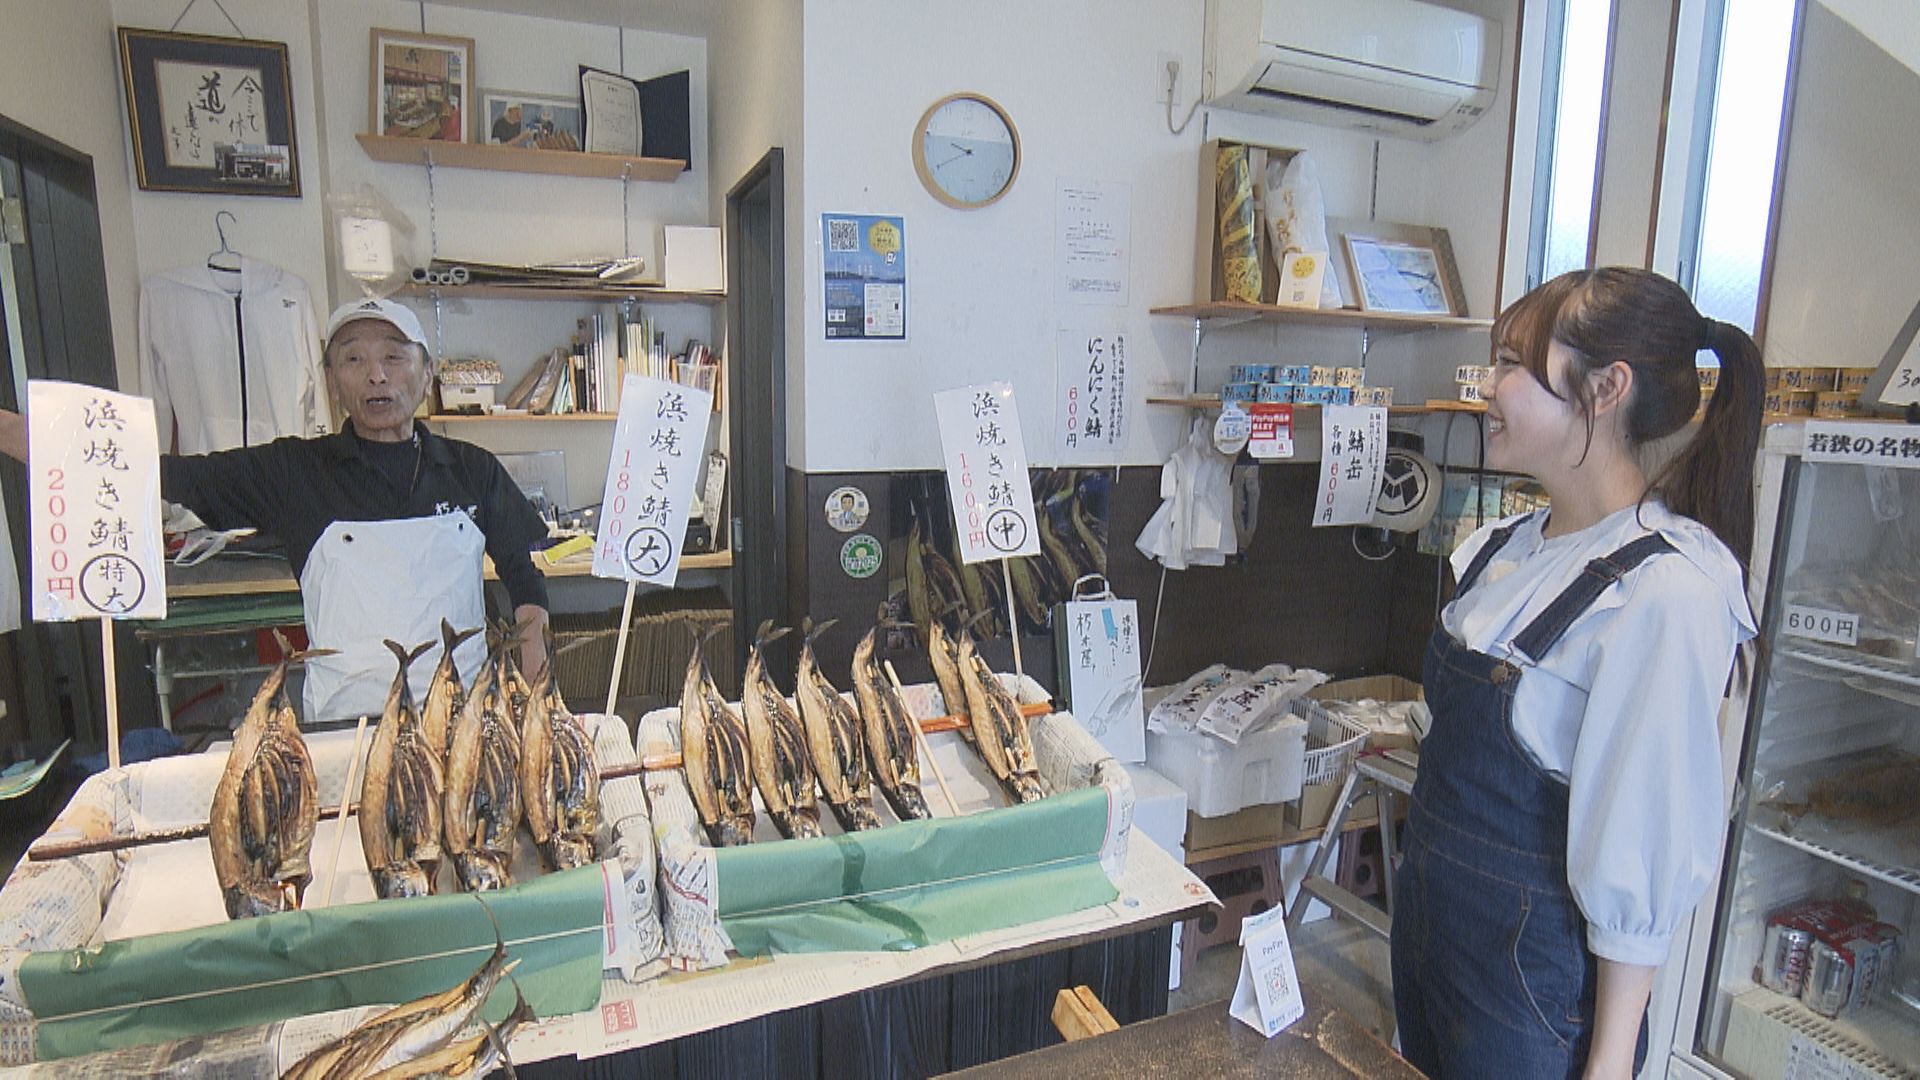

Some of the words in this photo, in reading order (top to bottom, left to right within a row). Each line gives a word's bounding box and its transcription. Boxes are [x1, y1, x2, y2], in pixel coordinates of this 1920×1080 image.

[1067, 387, 1078, 448] 600円
[1085, 337, 1105, 438] にんにく鯖
[84, 399, 134, 550] 浜焼き鯖
[638, 391, 689, 527] 浜焼き鯖
[972, 391, 1016, 508] 浜焼き鯖
[1809, 432, 1920, 459] 若狭の名物
[960, 453, 986, 550] 1600円
[1322, 462, 1340, 523] 600円
[47, 467, 75, 601] 2000円
[628, 534, 661, 571] 大
[993, 515, 1017, 547] 中
[100, 560, 127, 608] 特大
[1789, 613, 1854, 638] 600円
